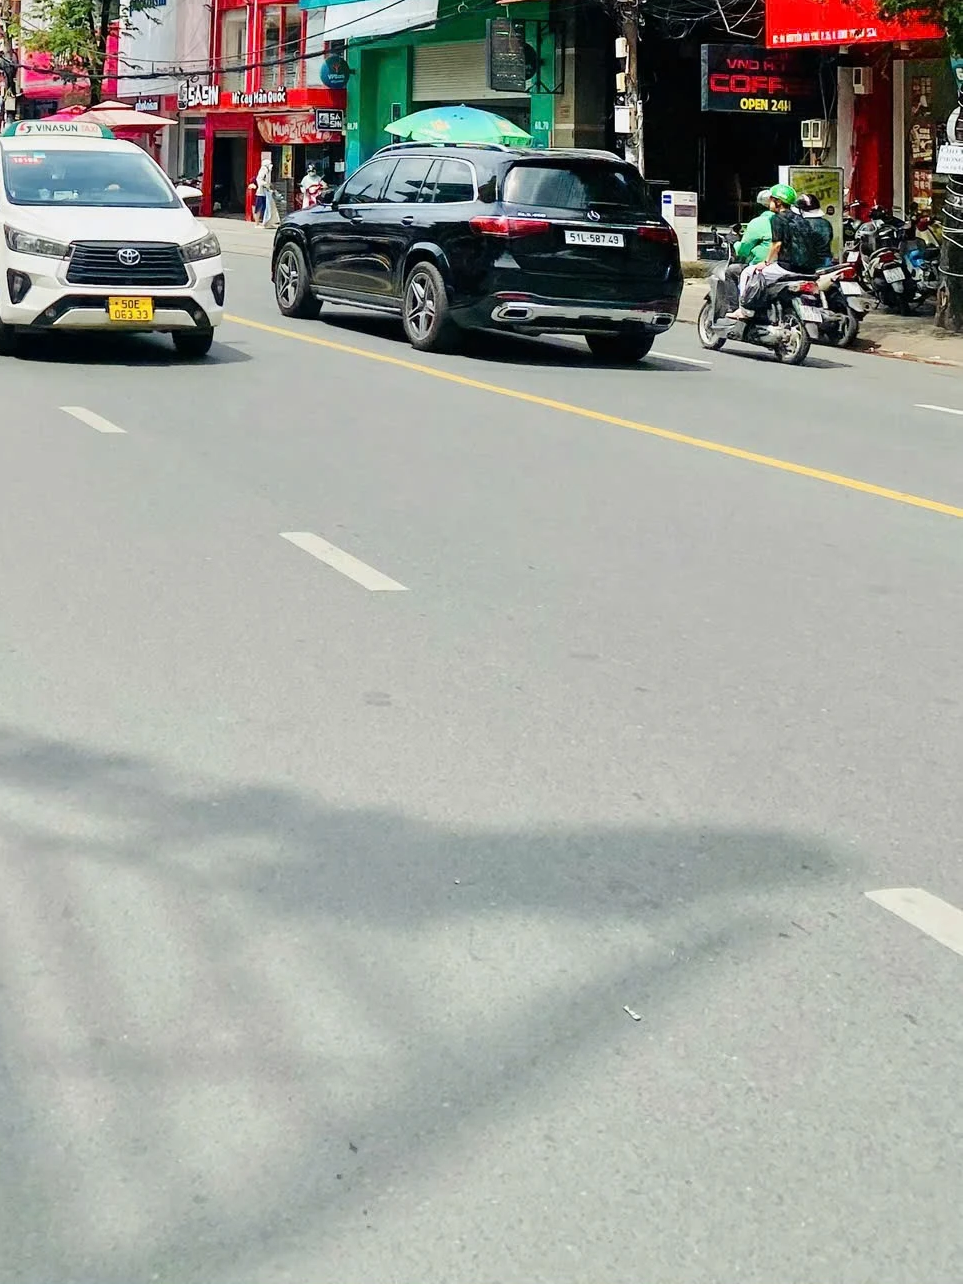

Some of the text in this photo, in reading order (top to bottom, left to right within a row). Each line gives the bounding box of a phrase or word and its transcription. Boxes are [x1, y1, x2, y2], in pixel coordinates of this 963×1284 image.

[188, 85, 219, 106] SASIN
[241, 92, 253, 107] cay
[268, 86, 286, 103] Quốc
[740, 98, 792, 112] OPEN 24H
[36, 124, 78, 132] VINASUN
[569, 232, 619, 245] 51L-587.49
[121, 299, 140, 309] 50E
